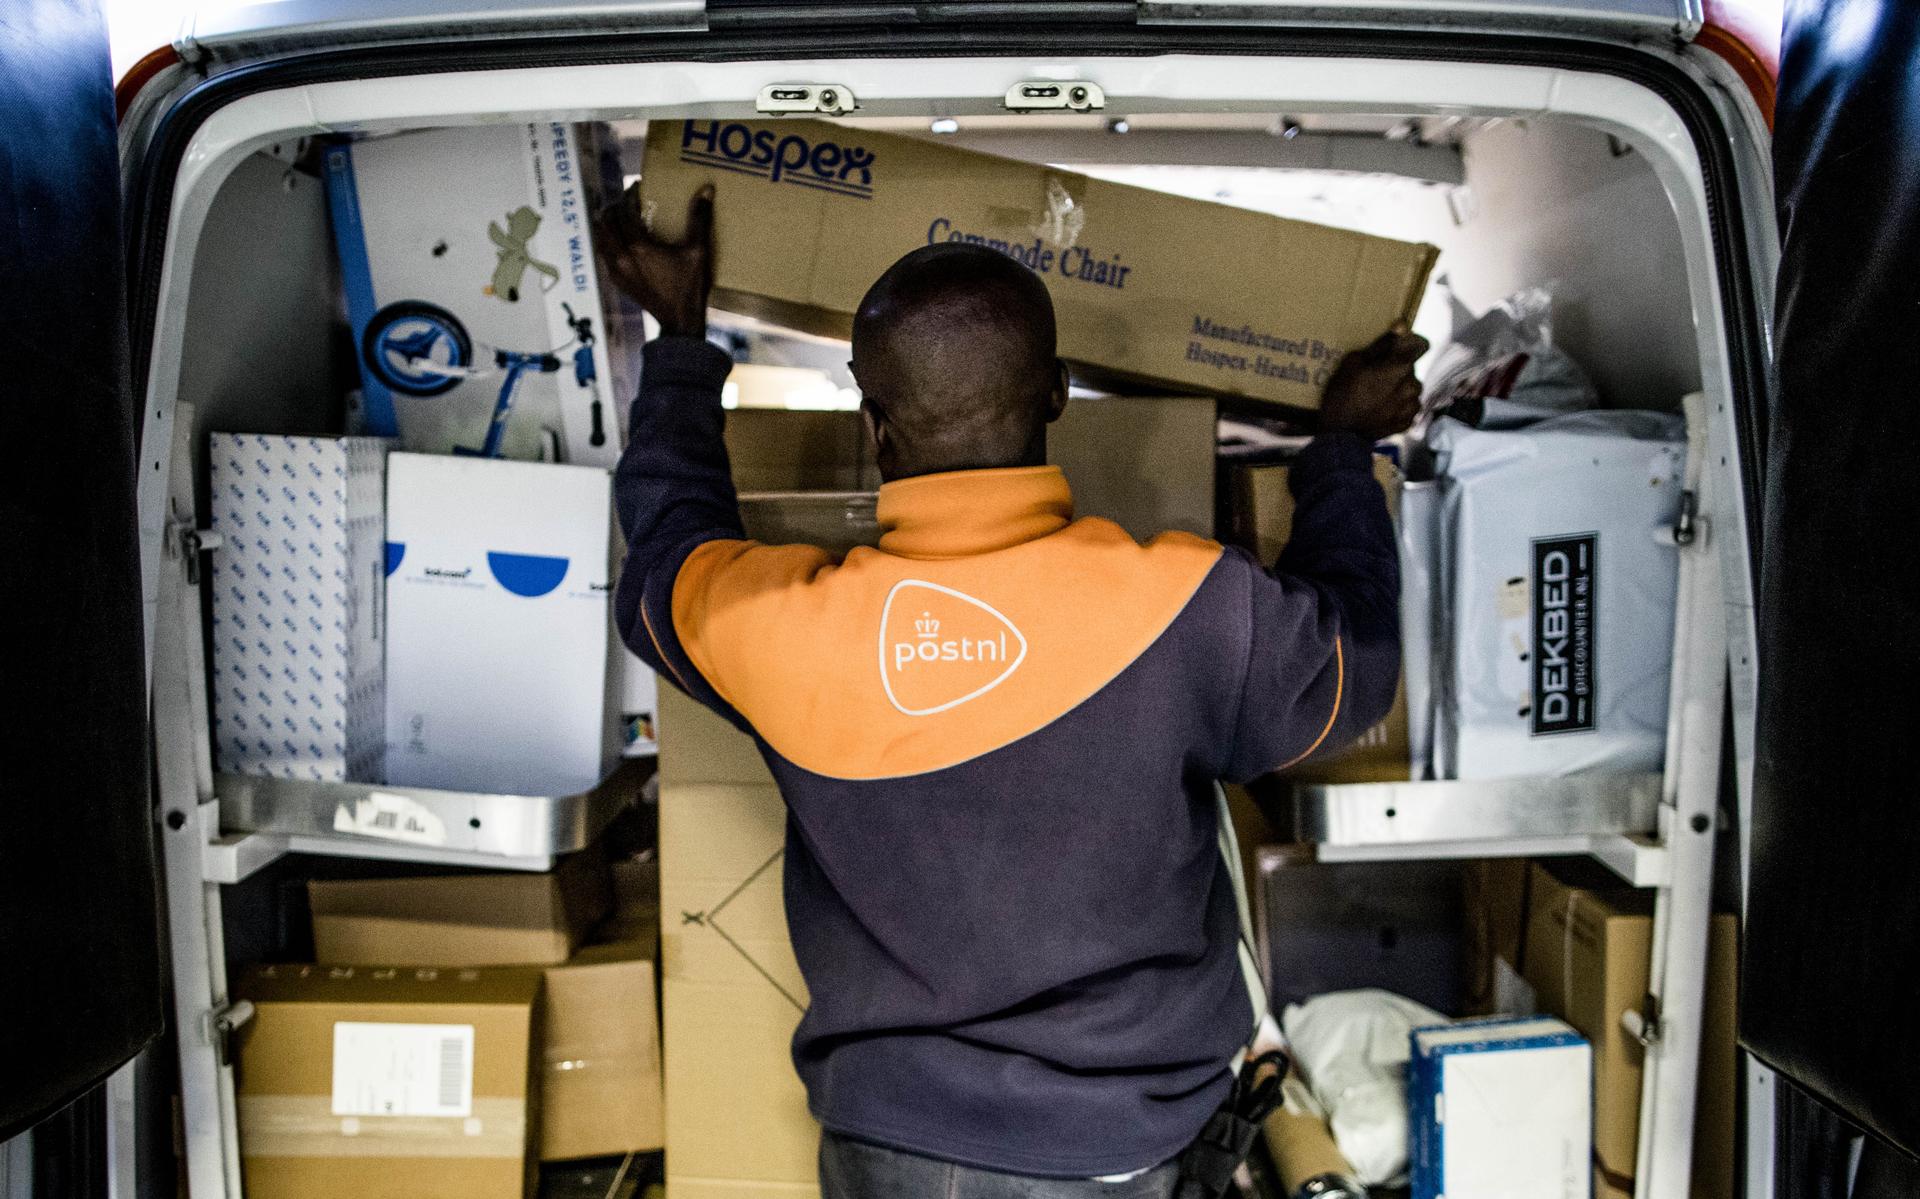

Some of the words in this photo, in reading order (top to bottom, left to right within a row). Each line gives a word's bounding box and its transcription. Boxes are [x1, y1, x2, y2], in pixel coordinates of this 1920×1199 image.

[681, 119, 876, 184] Hospex
[568, 235, 588, 293] WALDI
[1059, 246, 1132, 289] Chair
[1192, 314, 1309, 357] Manufactured
[895, 631, 1006, 672] postnl
[1542, 550, 1570, 724] DEKBED
